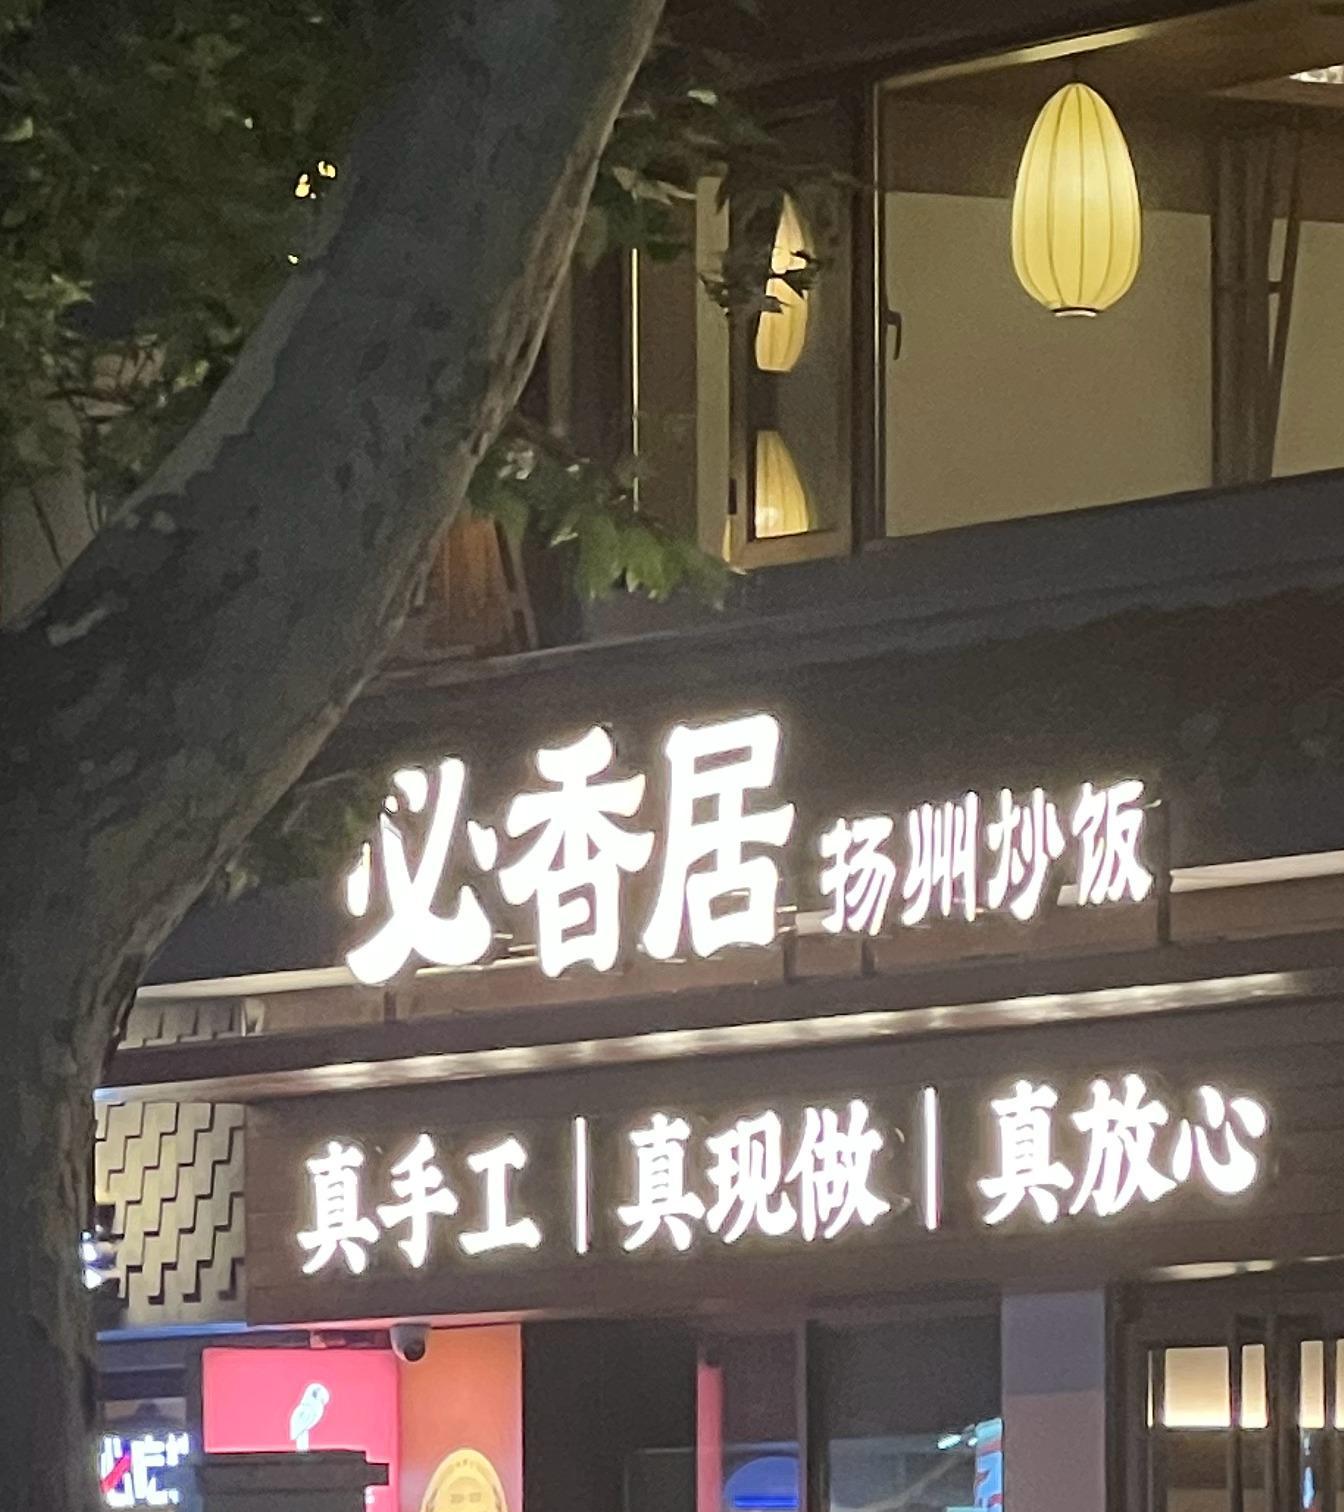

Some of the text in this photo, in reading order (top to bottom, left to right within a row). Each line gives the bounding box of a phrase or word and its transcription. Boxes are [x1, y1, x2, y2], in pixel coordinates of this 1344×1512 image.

[346, 713, 1152, 985] 必香居 扬州炒饭
[297, 1074, 1268, 1274] 真手工 真现做 真放心
